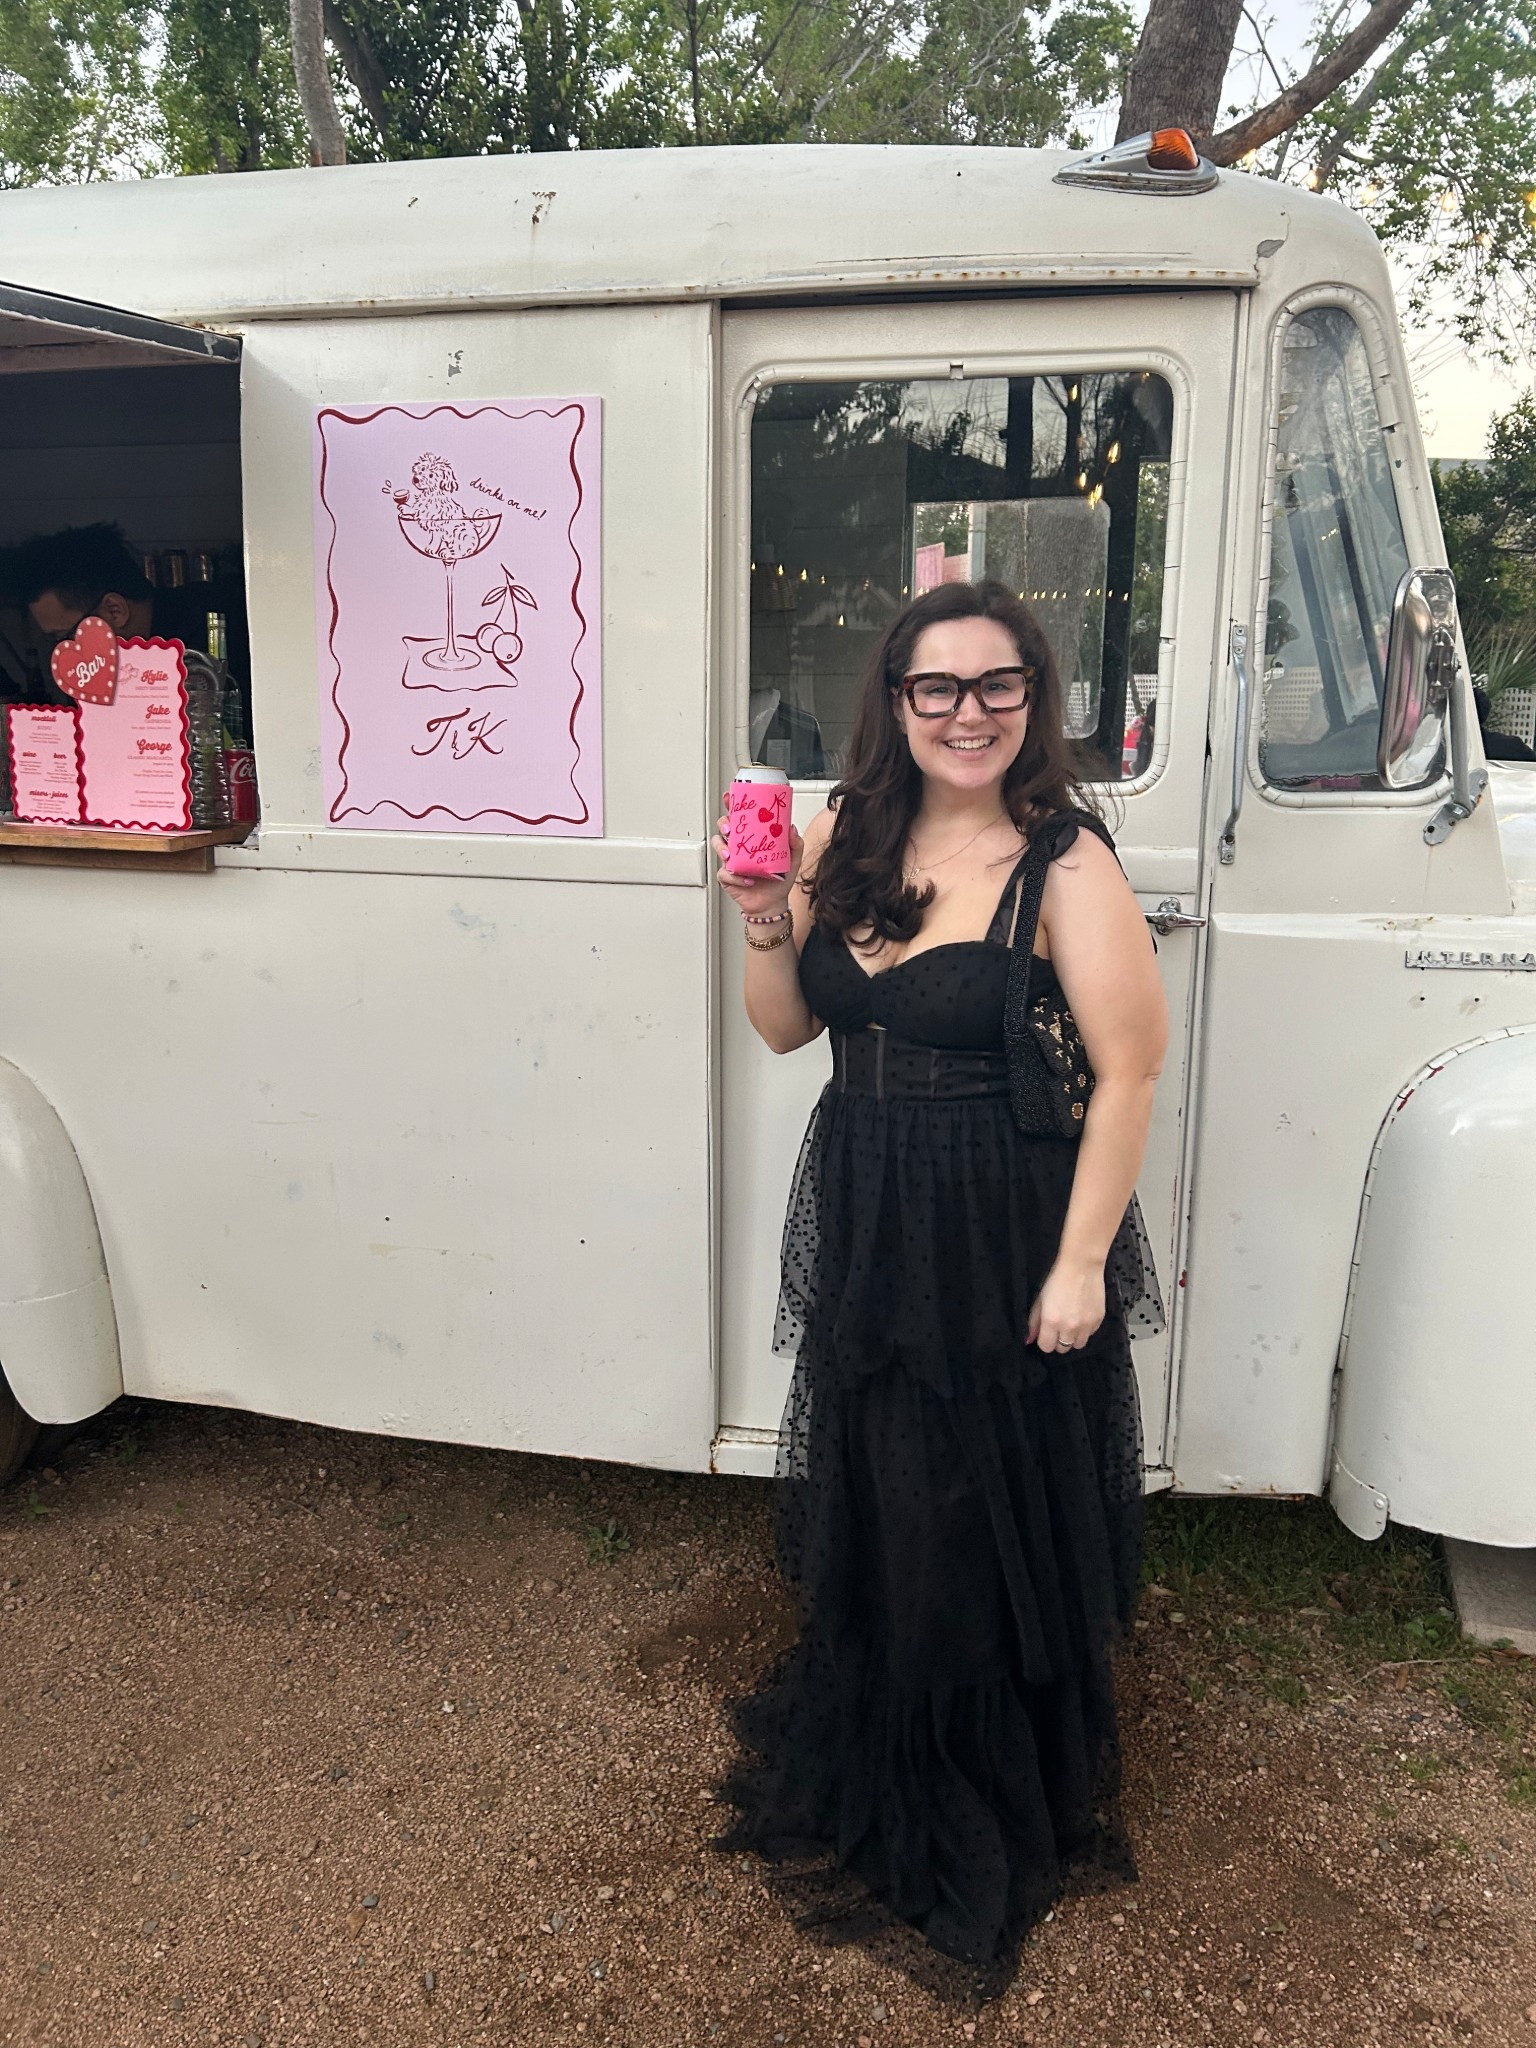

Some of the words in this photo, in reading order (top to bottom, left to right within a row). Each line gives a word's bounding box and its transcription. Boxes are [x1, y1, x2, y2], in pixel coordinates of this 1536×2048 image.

[469, 477, 505, 502] drinks
[507, 499, 521, 509] on
[523, 507, 547, 520] me!
[76, 654, 106, 688] Bar
[141, 669, 169, 685] Kylie
[145, 703, 171, 719] Jake
[136, 738, 173, 755] George
[729, 793, 757, 814] Jake
[735, 815, 749, 835] &
[735, 834, 777, 860] Kylie
[1404, 950, 1536, 967] INTERNA
